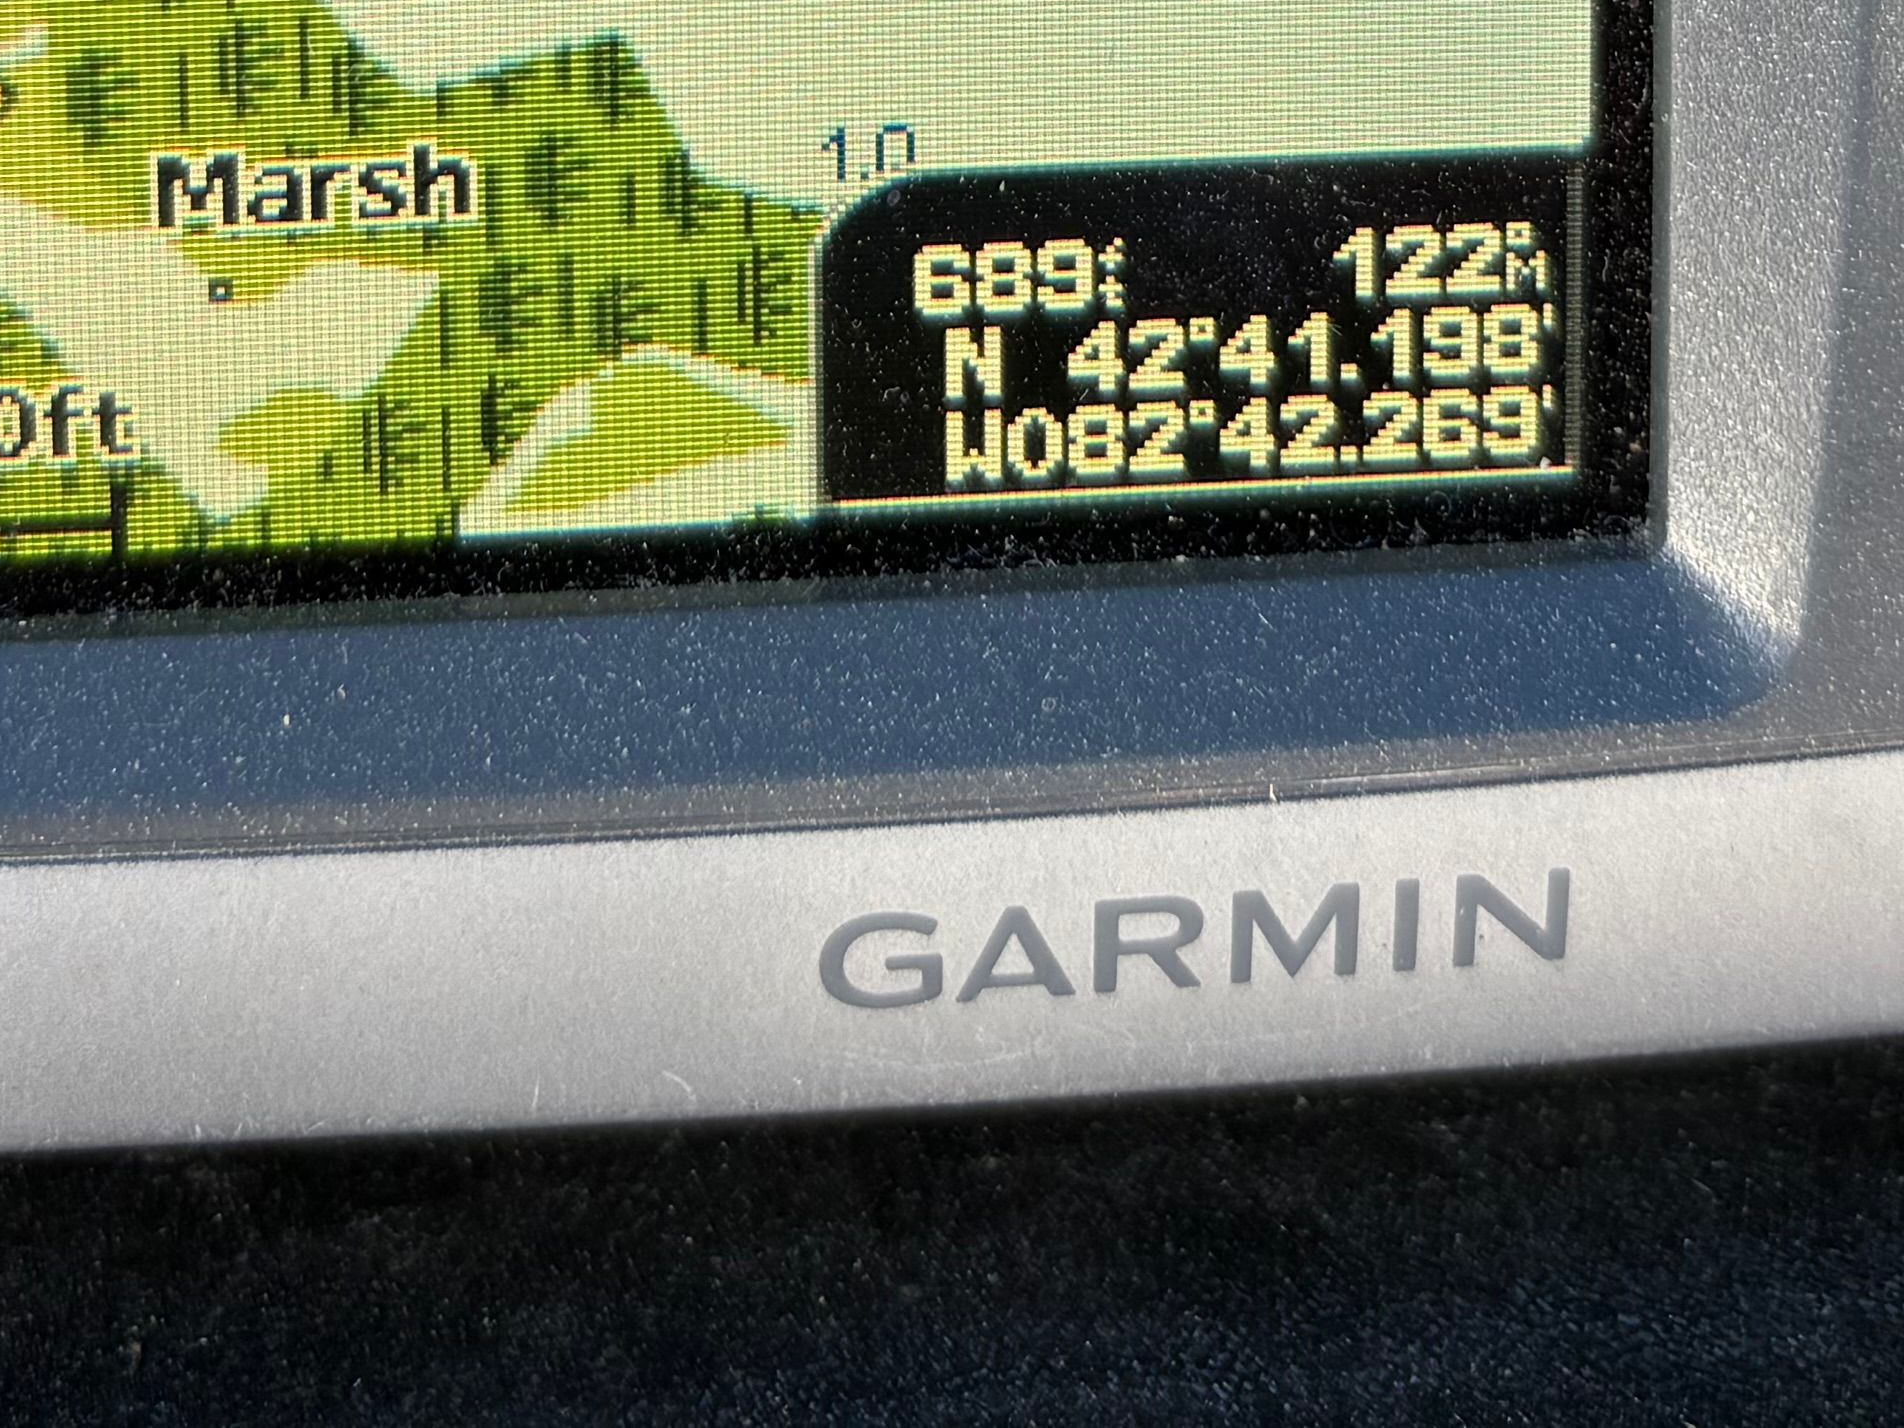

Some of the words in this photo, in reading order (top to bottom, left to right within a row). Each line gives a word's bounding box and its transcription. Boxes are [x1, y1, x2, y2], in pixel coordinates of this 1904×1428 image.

[156, 146, 474, 226] Marsh
[944, 324, 1004, 400] N
[819, 866, 1572, 1009] GARMIN
